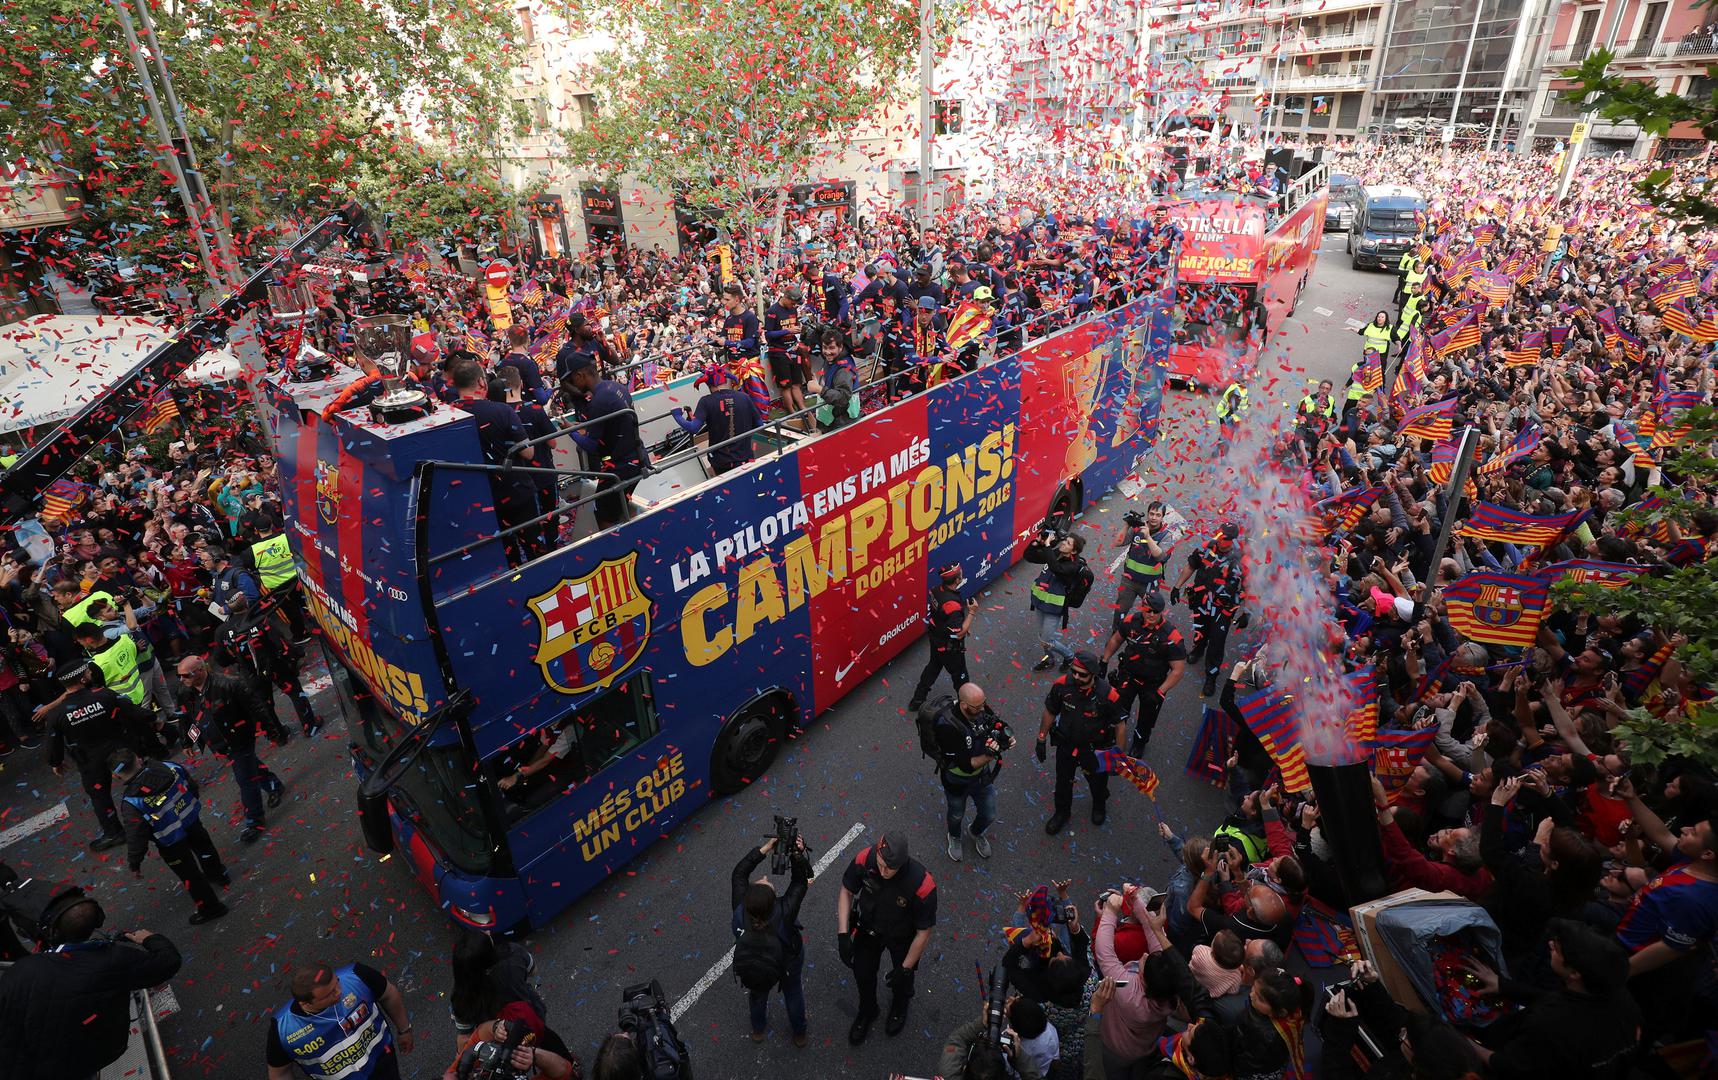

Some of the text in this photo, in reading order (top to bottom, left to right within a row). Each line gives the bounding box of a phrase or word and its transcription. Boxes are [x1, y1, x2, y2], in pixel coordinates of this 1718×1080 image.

[820, 190, 844, 200] orange
[1171, 216, 1254, 235] ESTRELLA
[1194, 233, 1224, 242] DAMM
[670, 435, 930, 592] LA PILOTA ENS FA MÉS
[681, 422, 1015, 667] CAMPIONS!
[856, 537, 926, 600] DOBLET
[928, 512, 964, 552] 2017
[978, 482, 1011, 519] 2018
[573, 612, 617, 643] FCB
[886, 611, 920, 641] Rakuten
[66, 701, 104, 721] POLICIA
[572, 789, 632, 842] MÉS
[581, 778, 686, 862] UN CLUB
